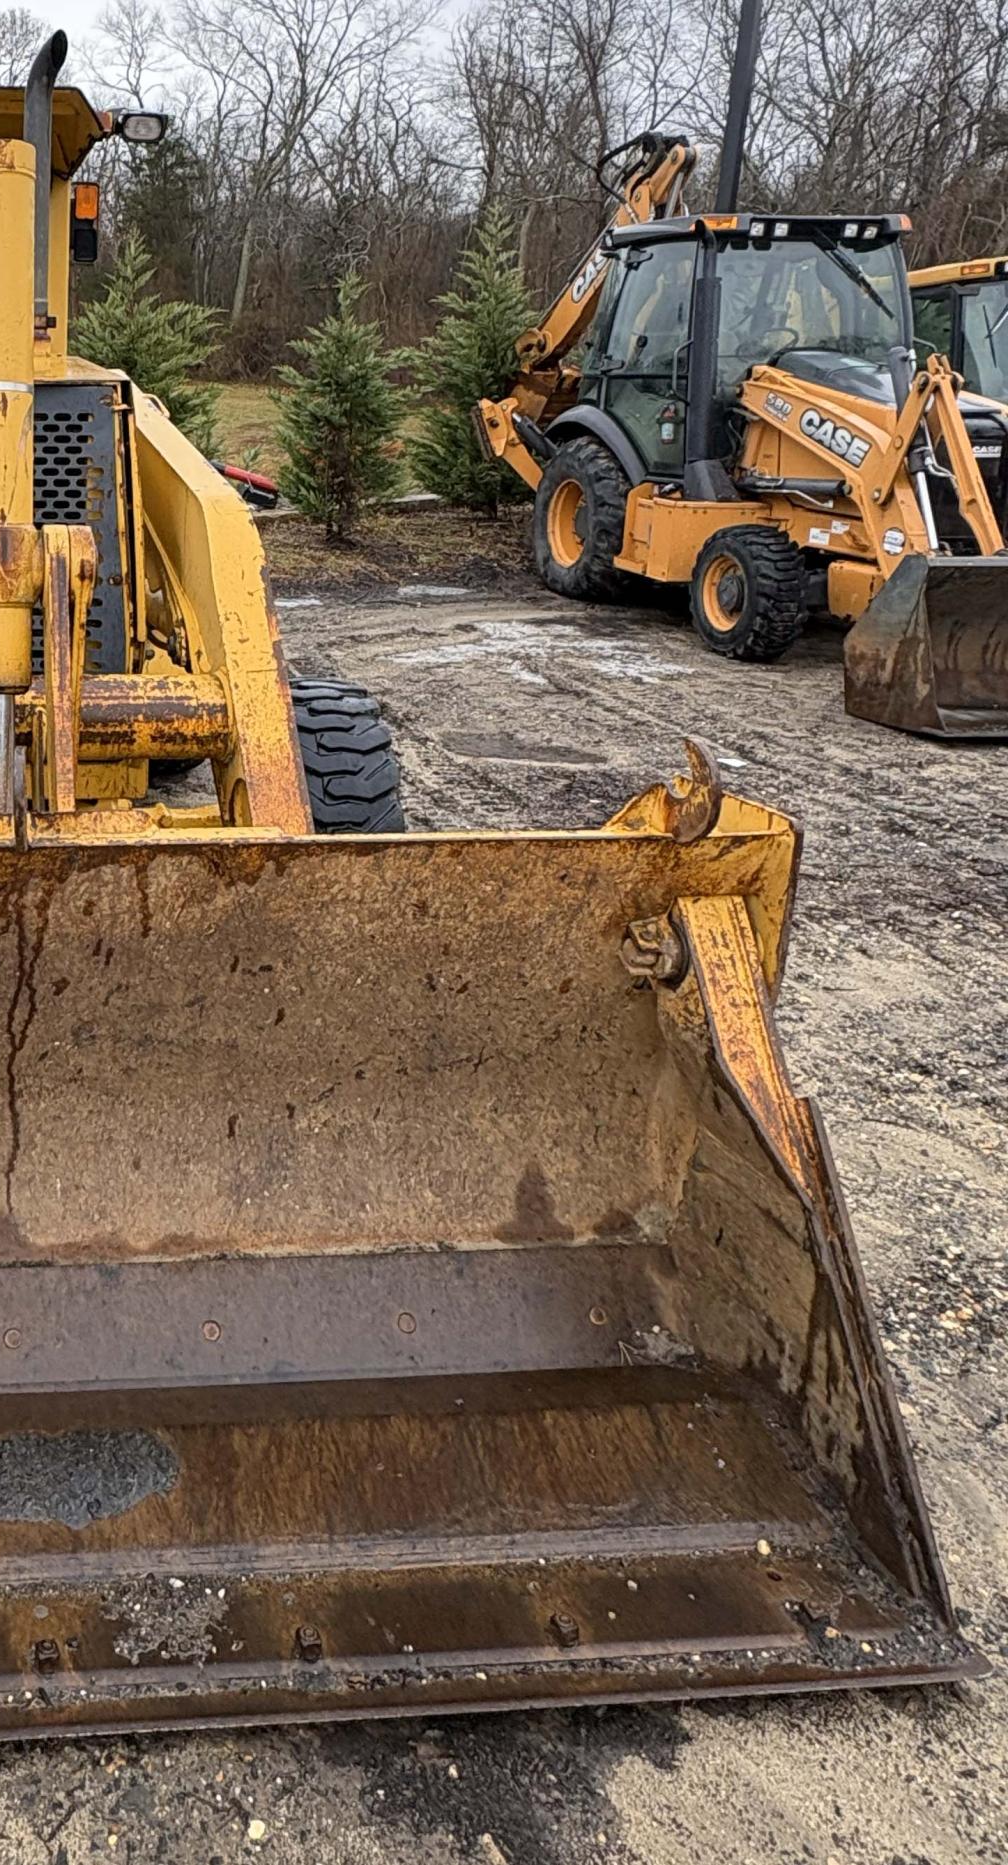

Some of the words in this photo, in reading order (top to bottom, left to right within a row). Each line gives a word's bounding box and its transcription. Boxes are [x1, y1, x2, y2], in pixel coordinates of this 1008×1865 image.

[572, 247, 608, 302] CAS
[767, 391, 792, 415] 580
[800, 409, 871, 467] CASE
[972, 445, 1002, 453] CASE
